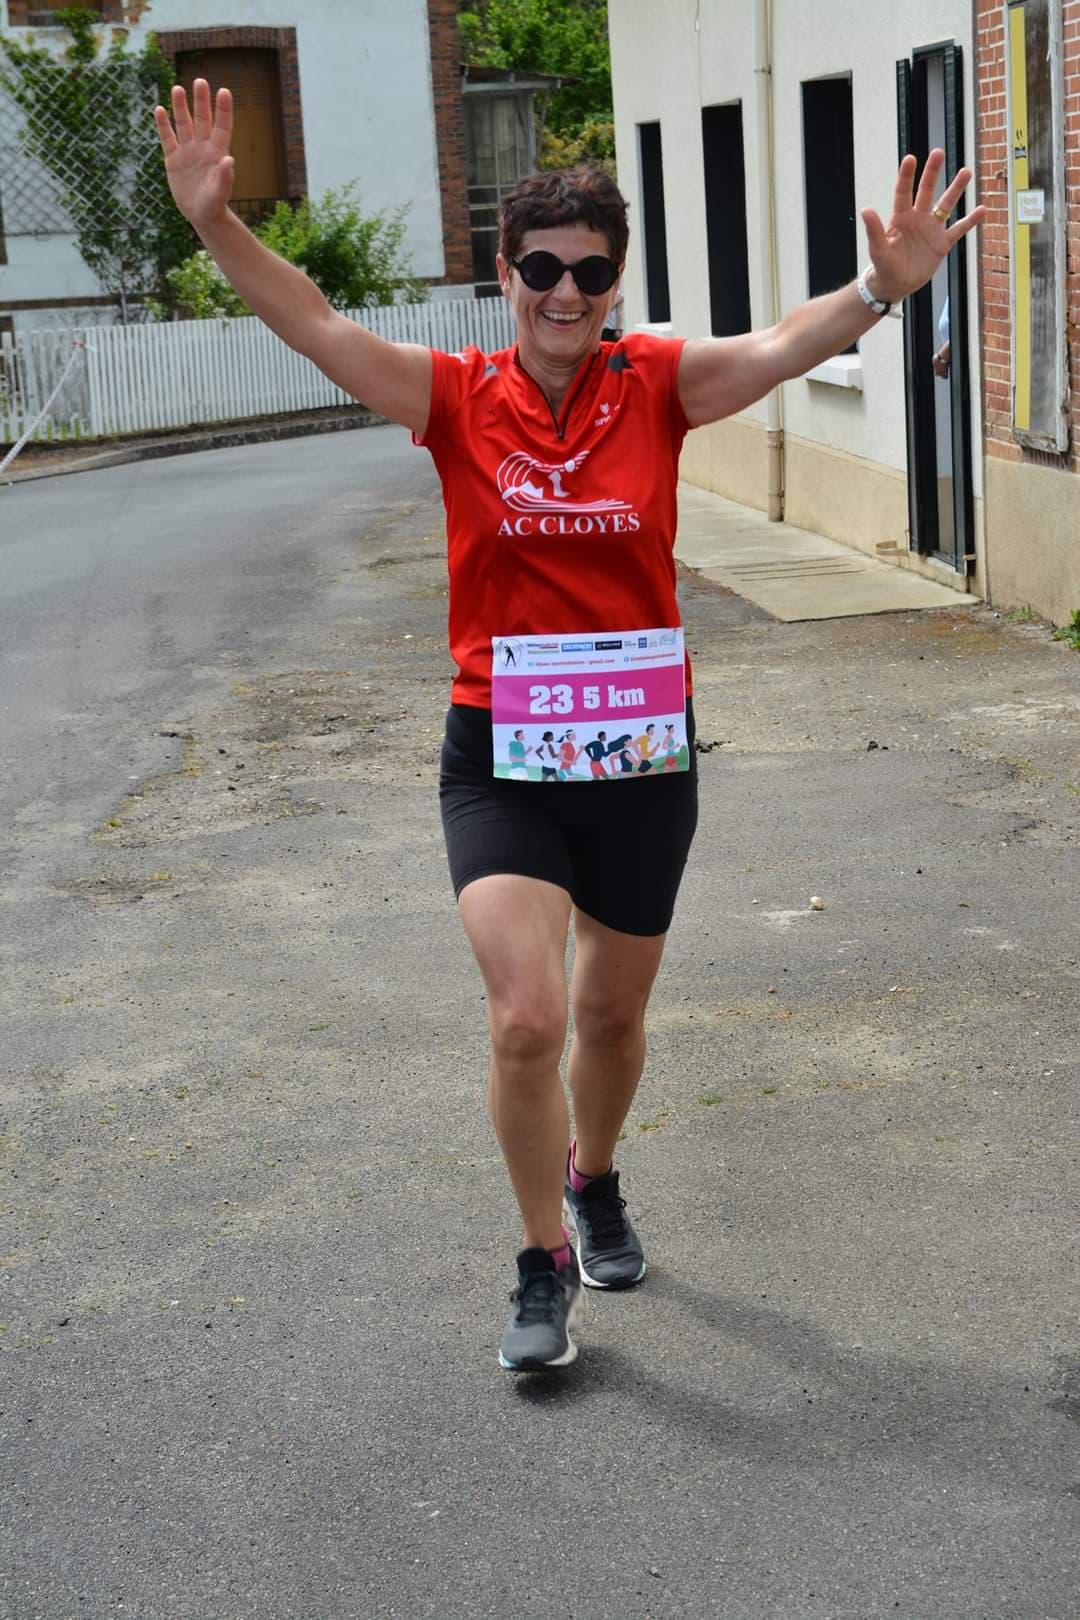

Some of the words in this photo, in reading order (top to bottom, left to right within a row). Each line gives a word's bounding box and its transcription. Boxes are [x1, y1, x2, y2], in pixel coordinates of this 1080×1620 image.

[498, 516, 532, 536] AC
[539, 512, 641, 536] CLOYES
[529, 683, 574, 715] 23
[583, 685, 600, 710] 5
[607, 685, 645, 709] km
